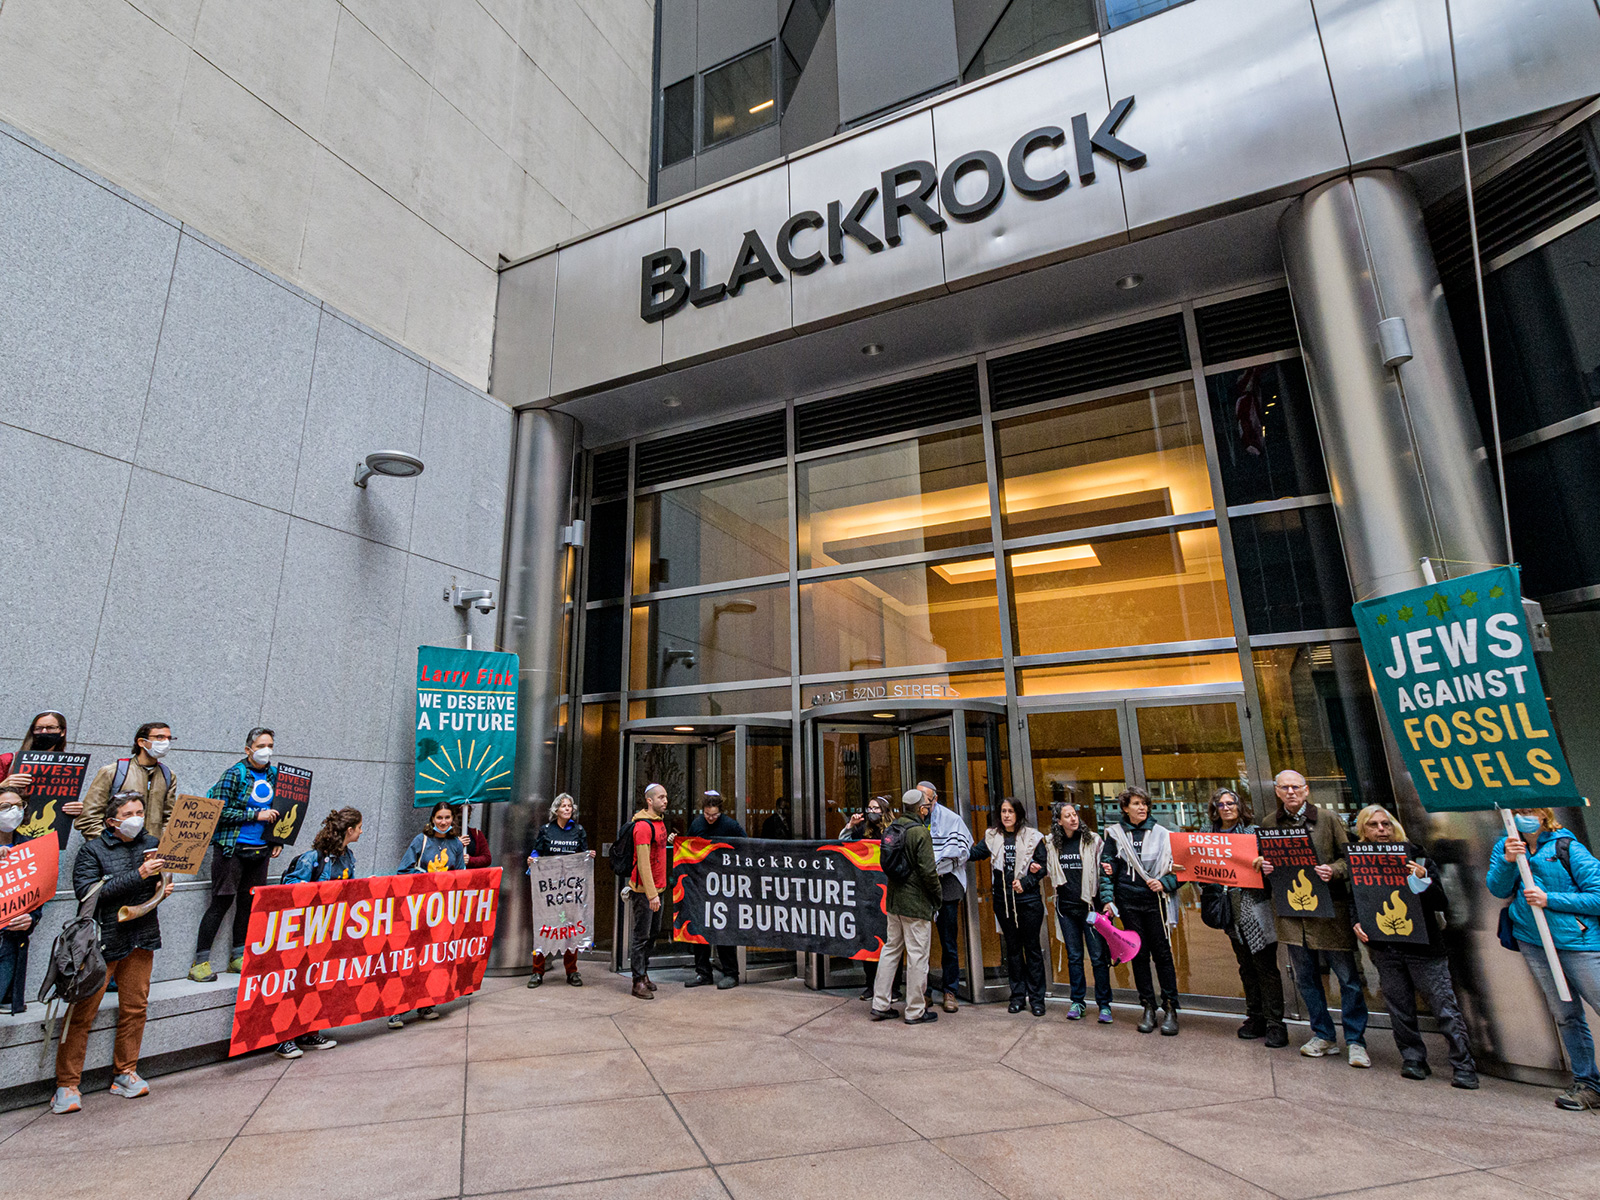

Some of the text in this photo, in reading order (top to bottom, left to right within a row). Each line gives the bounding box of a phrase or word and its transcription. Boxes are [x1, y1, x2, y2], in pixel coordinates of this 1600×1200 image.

[640, 94, 1147, 323] BLACKROCK
[1385, 612, 1523, 680] JEWS
[421, 665, 514, 688] Larry Fink
[853, 685, 886, 699] 52ND
[894, 684, 949, 697] STREET
[1398, 665, 1528, 714] AGAINST
[419, 693, 515, 711] WE DESERVE
[417, 711, 515, 731] A FUTURE
[1403, 702, 1550, 752] FOSSIL
[22, 754, 55, 762] L'DOR
[19, 764, 84, 776] DIVEST
[1419, 748, 1561, 792] FUELS
[277, 773, 310, 787] DIVEST
[24, 785, 79, 796] UTURE
[275, 789, 309, 802] FUTURE
[276, 782, 309, 794] FOR OUR
[182, 801, 198, 810] NO
[188, 811, 215, 820] MORE
[174, 819, 201, 830] DIRTY
[178, 831, 209, 840] MONEY
[1188, 834, 1232, 845] FOSSIL
[1261, 837, 1309, 848] DIVEST
[0, 847, 35, 869] SSIL
[1189, 847, 1233, 858] FUELS
[721, 853, 837, 871] BlackRock
[1264, 856, 1318, 867] FUTURE
[1349, 855, 1408, 866] DIVEST
[1194, 865, 1237, 879] SHANDA
[24, 881, 31, 889] A
[538, 877, 585, 892] BLACK
[1353, 875, 1408, 886] FUTUR
[705, 871, 857, 907] OUR FUTURE
[0, 887, 40, 918] HANDA
[546, 891, 583, 907] ROCK
[251, 889, 493, 956] JEWISH YOUTH
[704, 901, 857, 940] IS BURNING
[539, 920, 586, 940] HARMS
[242, 934, 488, 1002] FOR CLIMATE JUSTICE
